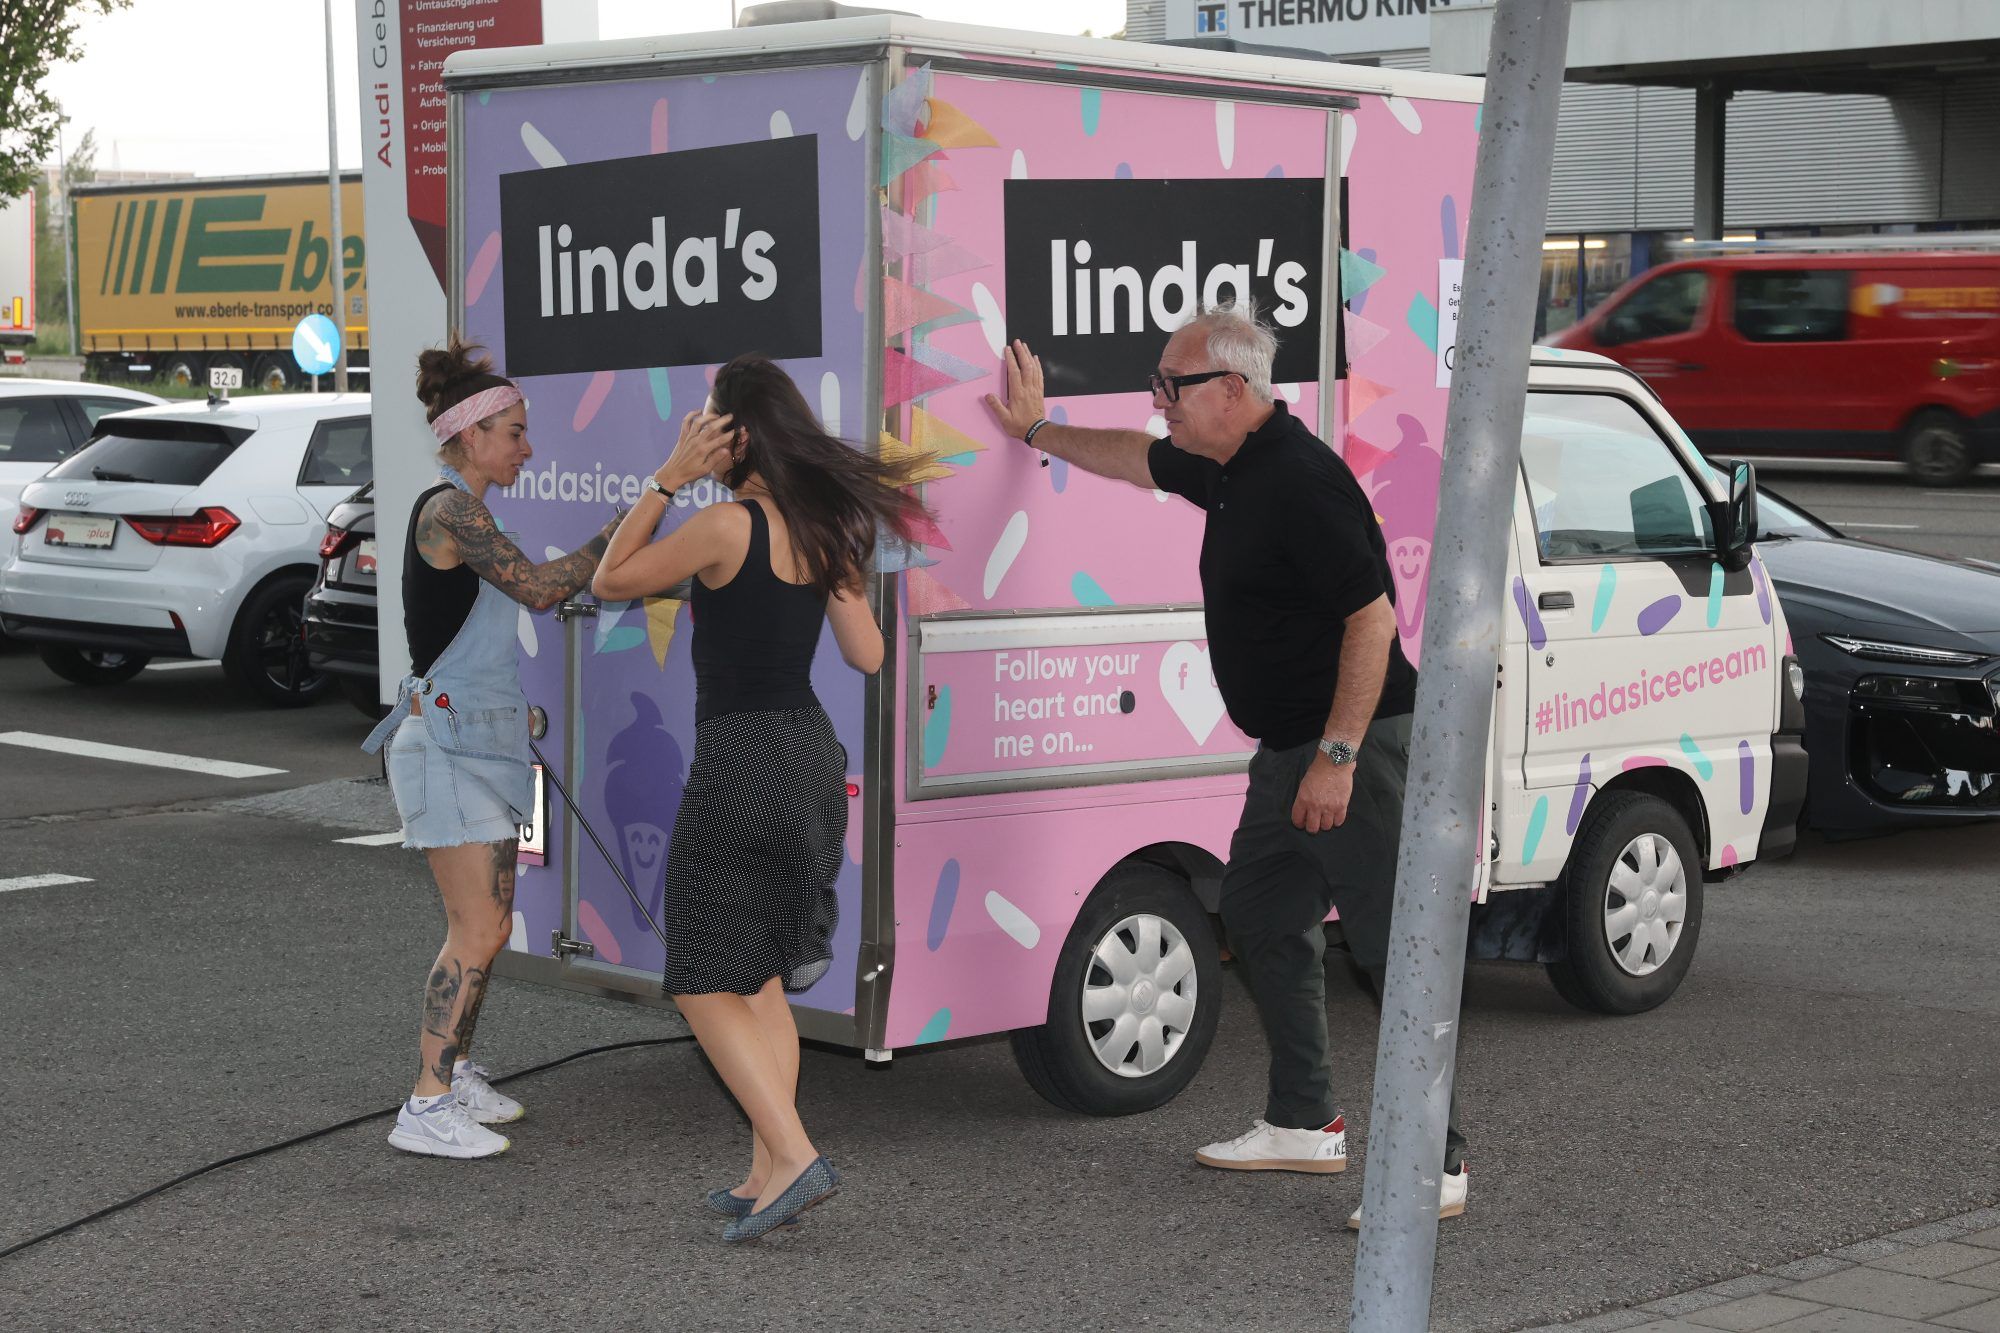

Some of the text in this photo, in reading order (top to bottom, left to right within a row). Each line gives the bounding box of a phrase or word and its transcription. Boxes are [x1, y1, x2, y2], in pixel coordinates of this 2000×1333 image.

[416, 17, 495, 34] Finanzierung und
[1238, 0, 1450, 29] THERMO KIN
[417, 35, 476, 48] Versicherung
[371, 0, 392, 168] Audi Geb
[175, 194, 366, 293] Ebe
[538, 207, 778, 318] linda's
[1050, 237, 1309, 336] linda's
[175, 301, 334, 321] www.eberle-transportco
[994, 650, 1140, 685] Follow your
[994, 685, 1122, 722] heart and
[1535, 643, 1767, 736] #lindasicecream
[994, 730, 1094, 759] me on...
